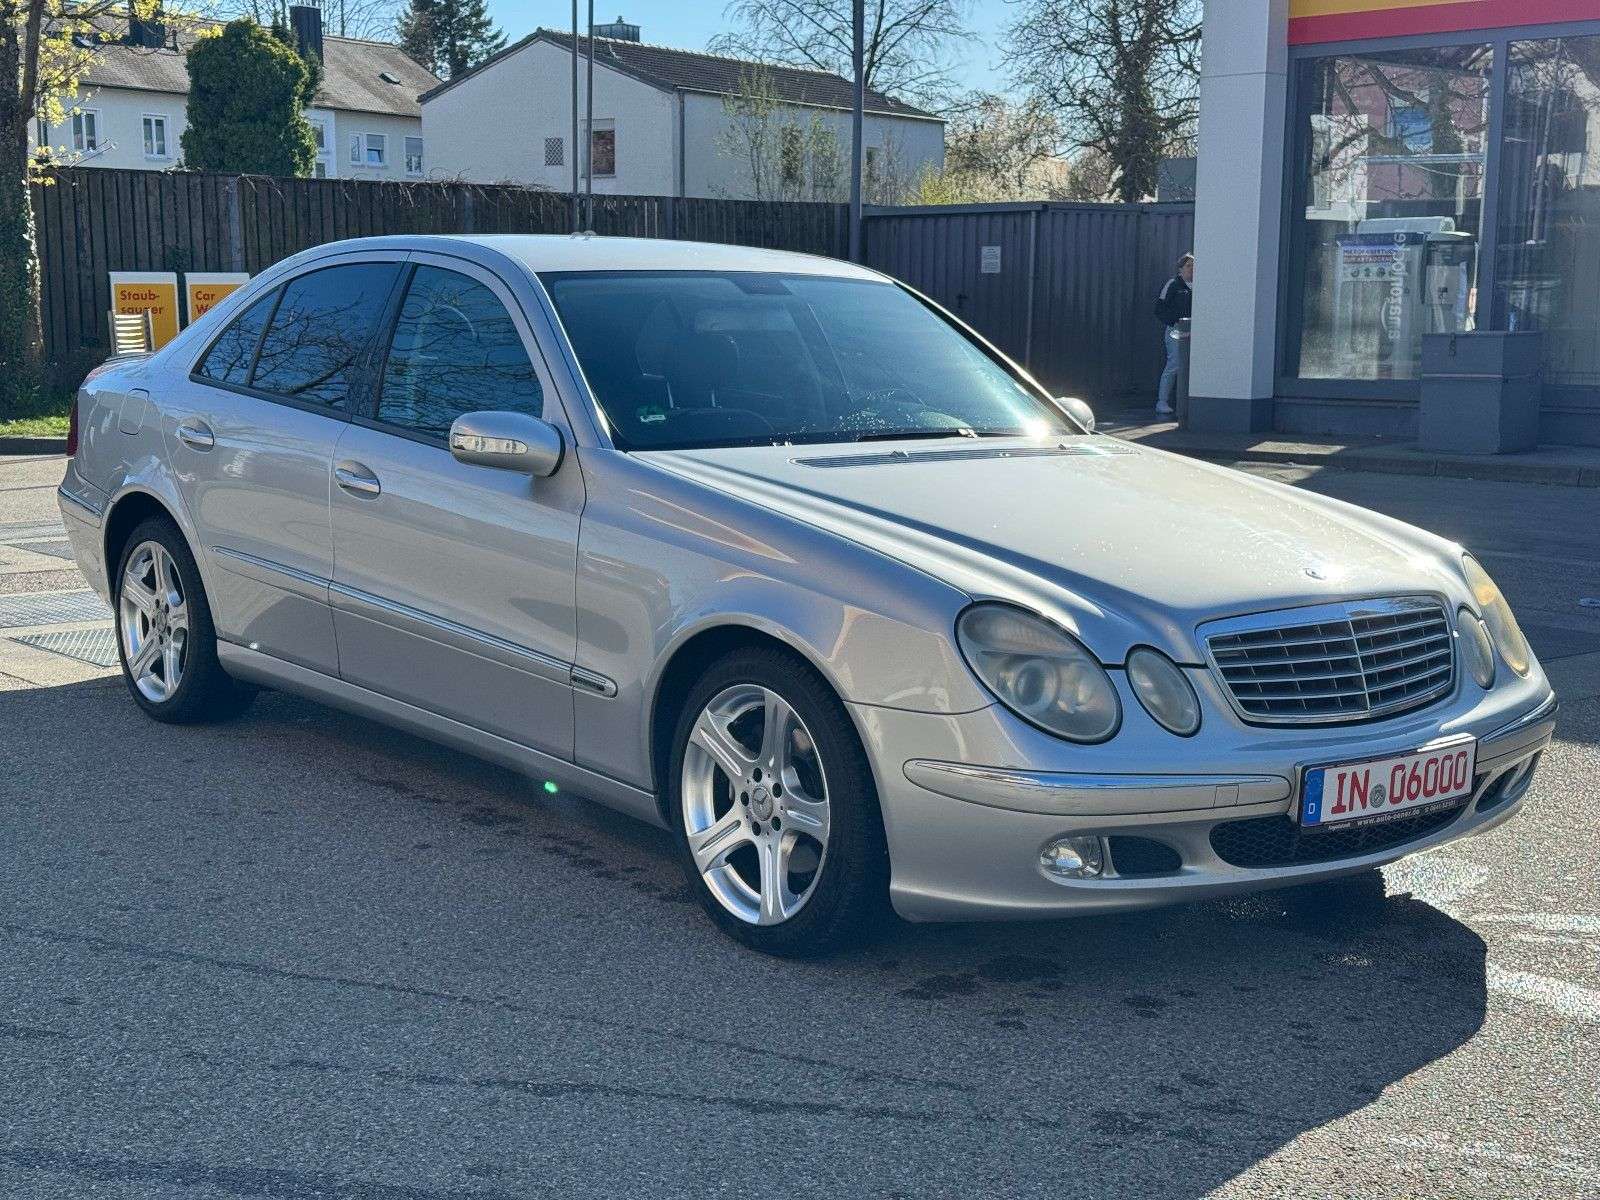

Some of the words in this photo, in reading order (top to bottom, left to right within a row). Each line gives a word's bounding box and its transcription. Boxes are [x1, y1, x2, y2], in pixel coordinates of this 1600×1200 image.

[120, 290, 160, 300] Staub-
[195, 291, 215, 300] Car
[196, 305, 212, 314] W
[1331, 769, 1370, 814] IN
[1389, 751, 1467, 805] 06000
[1308, 802, 1316, 815] D
